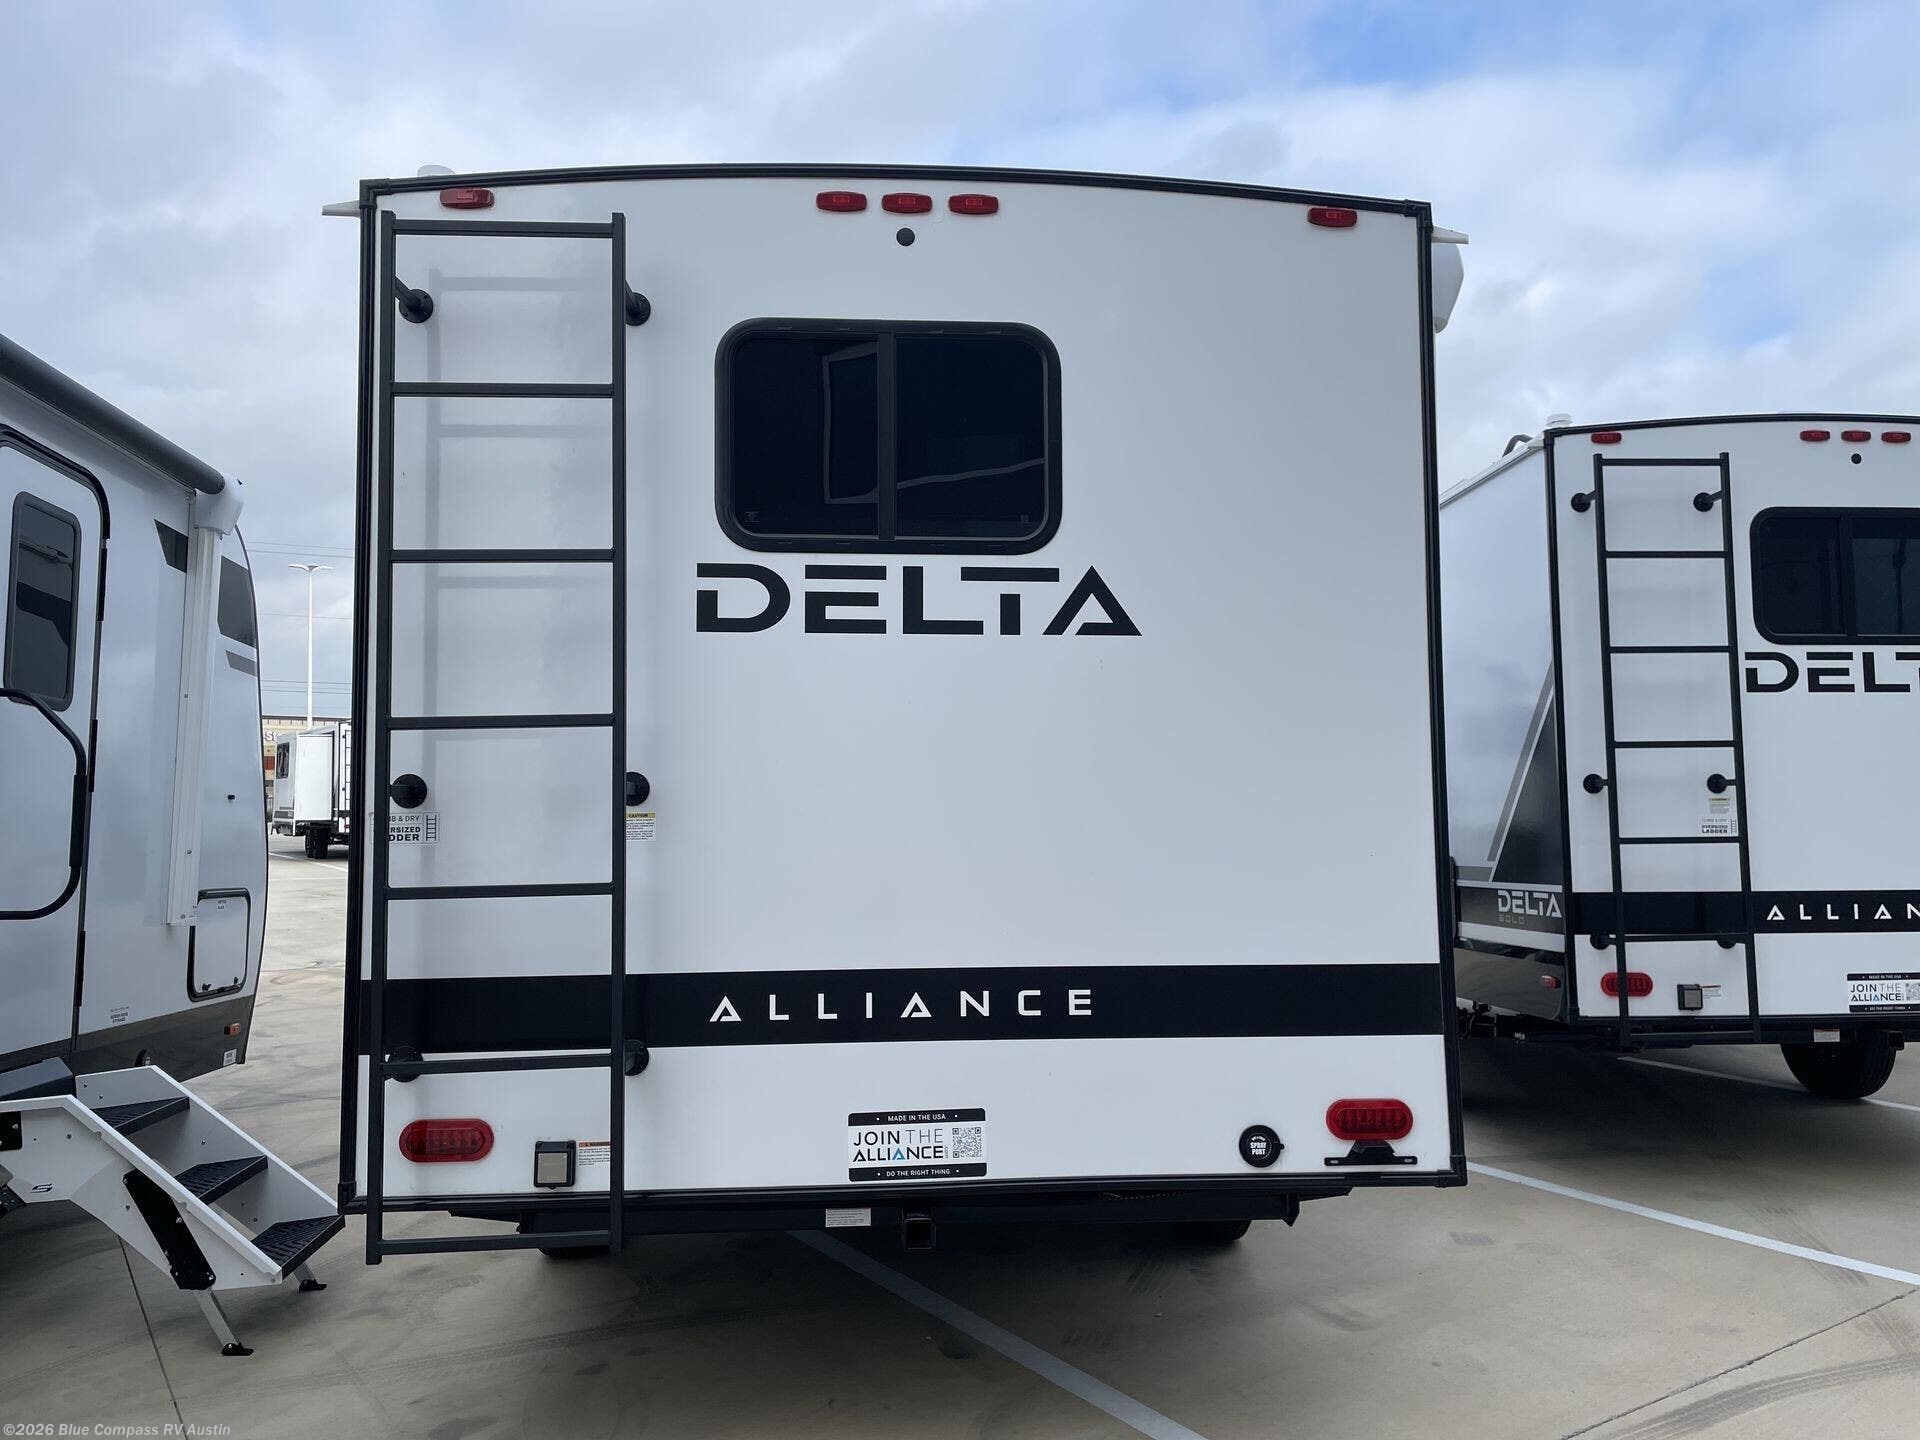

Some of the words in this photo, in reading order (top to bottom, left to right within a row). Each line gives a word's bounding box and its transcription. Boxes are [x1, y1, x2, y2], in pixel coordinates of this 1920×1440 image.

[696, 562, 1143, 636] DELTA
[389, 833, 420, 842] DDER
[390, 826, 421, 834] RSIZED
[1497, 889, 1562, 919] DELTA
[1766, 903, 1920, 921] ALLIAN
[1850, 983, 1877, 993] JOIN
[1880, 983, 1902, 992] THE
[709, 988, 1093, 1023] ALLIANCE
[1850, 993, 1902, 1002] ALLIANCE
[887, 1114, 908, 1122] MADE
[853, 1130, 900, 1146] JOIN
[904, 1128, 944, 1144] THE
[853, 1145, 944, 1162] ALLIANCE
